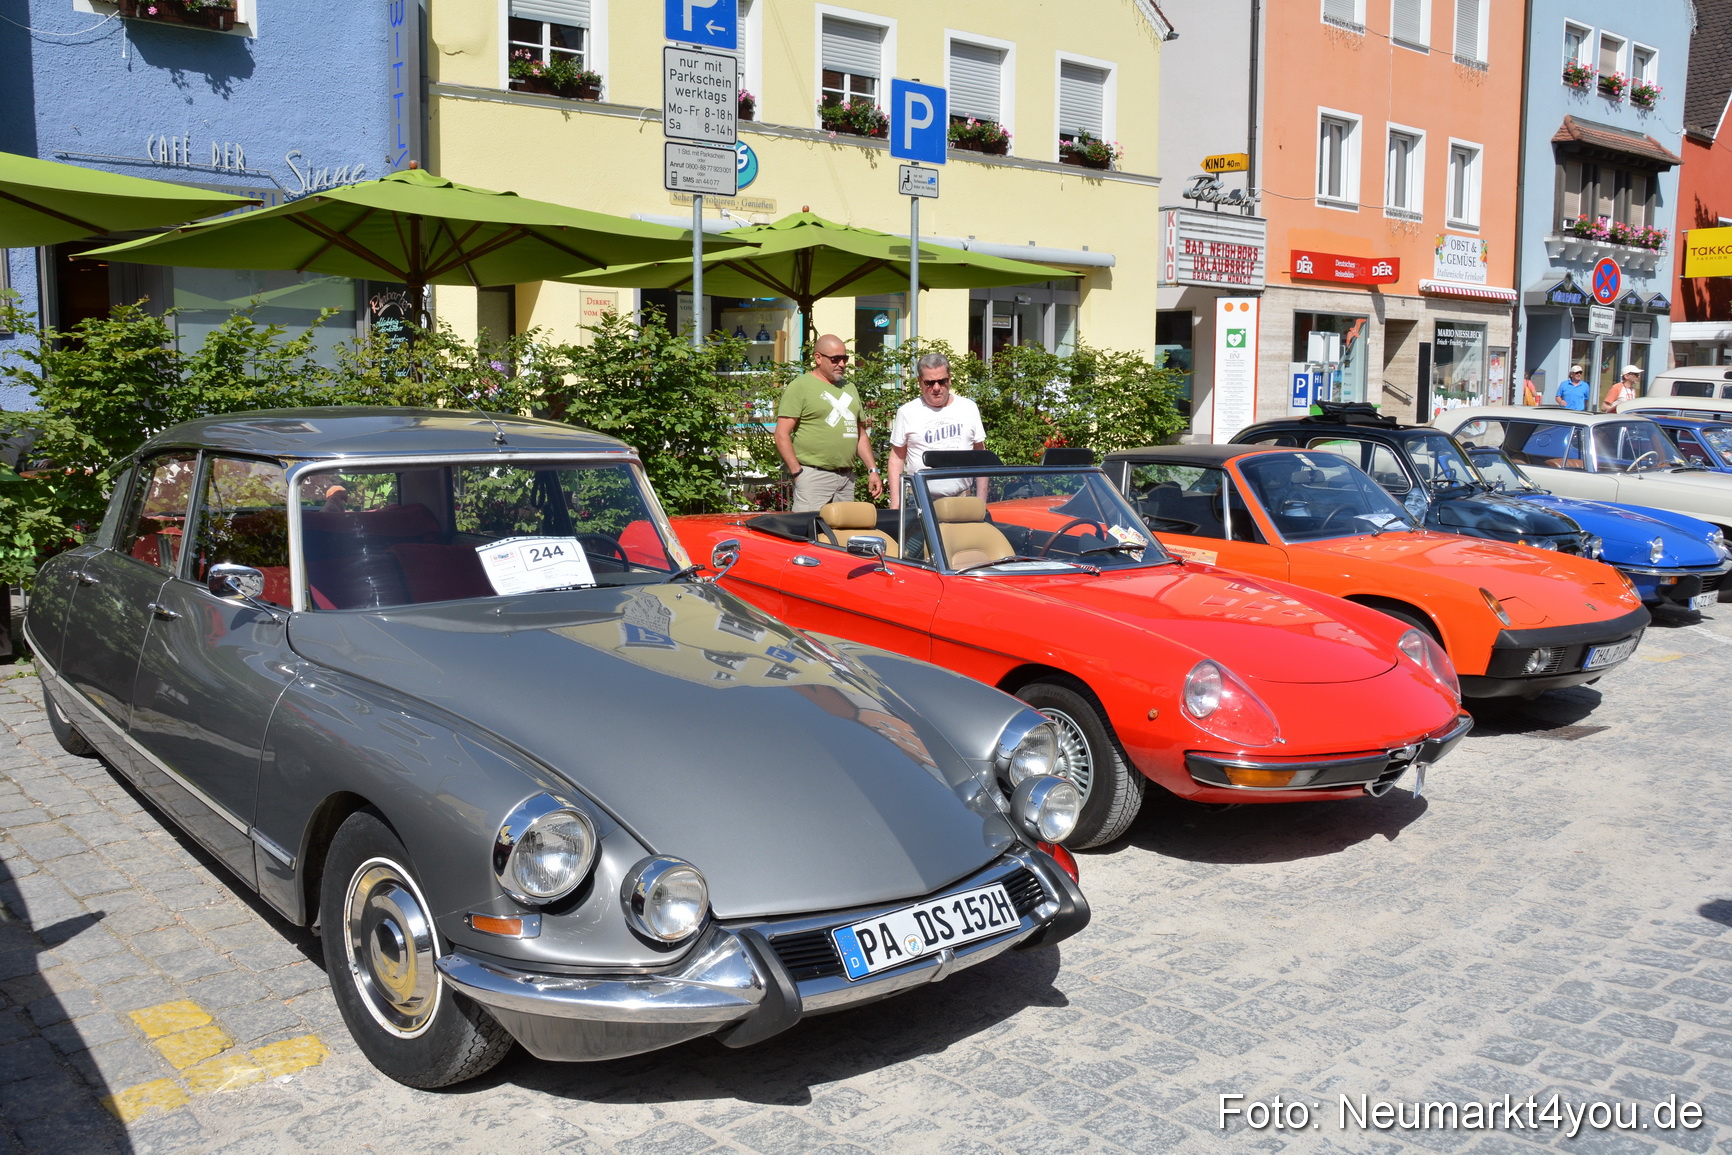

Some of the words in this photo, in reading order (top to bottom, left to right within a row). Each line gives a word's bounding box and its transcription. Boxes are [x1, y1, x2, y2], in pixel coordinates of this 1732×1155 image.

[679, 58, 699, 69] nur
[704, 61, 722, 72] mit
[669, 68, 732, 89] Parkschein
[675, 86, 727, 105] werktags
[669, 118, 681, 130] Sa
[904, 91, 934, 150] P
[147, 131, 191, 166] CAFÉ
[211, 140, 245, 171] DER
[700, 151, 726, 160] Parkschein
[669, 160, 685, 168] Anruf
[1205, 157, 1225, 170] KINO
[284, 149, 366, 195] Sinne
[682, 175, 695, 184] SMS
[1166, 211, 1176, 280] KINO
[1184, 240, 1204, 255] BAD
[1450, 238, 1470, 252] OBST
[1470, 242, 1477, 253] &
[1193, 255, 1255, 275] URLAUBSREIF
[1296, 259, 1314, 275] DER
[1446, 253, 1477, 268] GEMÜSE
[1192, 271, 1212, 282] GRACE
[1216, 273, 1223, 282] OF
[1228, 274, 1252, 285] MONACO
[1371, 264, 1393, 277] DER
[1437, 328, 1454, 338] MARIO
[1296, 378, 1306, 394] P
[529, 545, 564, 562] 244
[856, 922, 903, 966] PA
[912, 905, 955, 947] DS
[952, 889, 1015, 936] 152H
[852, 956, 860, 968] D
